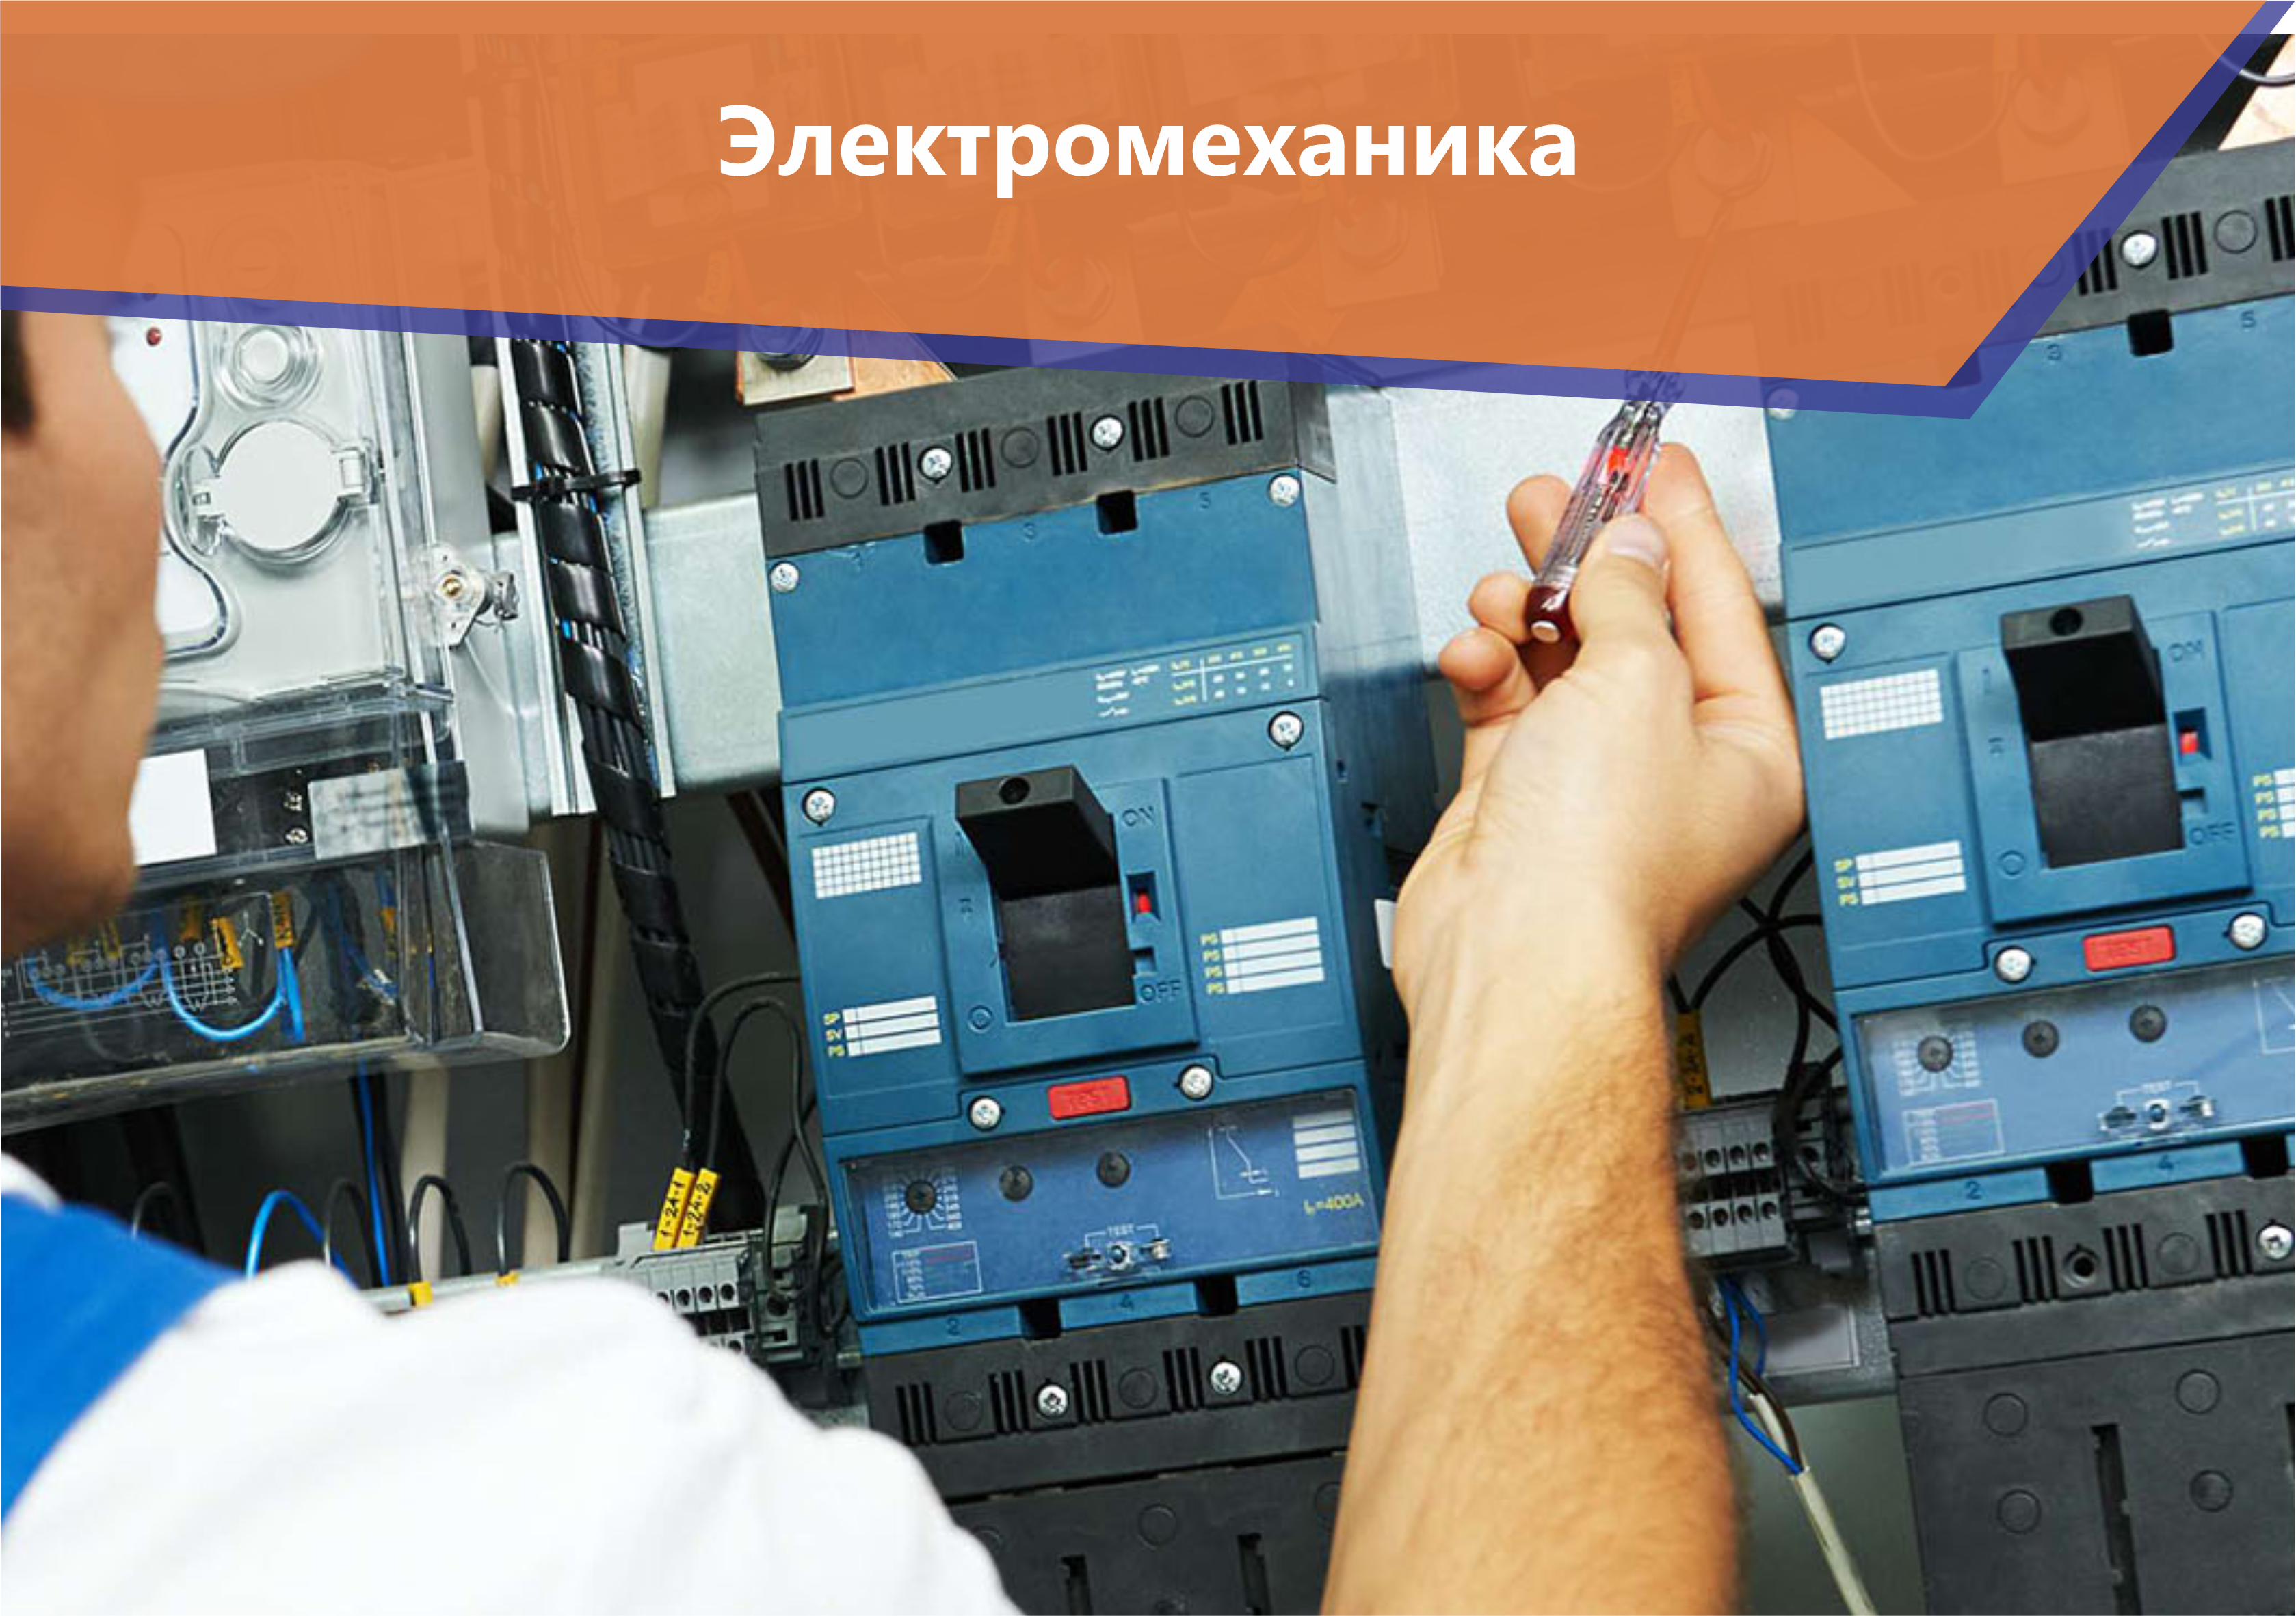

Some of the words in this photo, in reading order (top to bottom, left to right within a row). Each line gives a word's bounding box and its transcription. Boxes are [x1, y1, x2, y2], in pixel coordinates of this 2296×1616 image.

[1122, 805, 1156, 827] ON
[2189, 822, 2237, 845] OFF
[1139, 979, 1182, 1003] OFF
[1964, 1180, 1982, 1200] 2
[1297, 1269, 1312, 1288] 6
